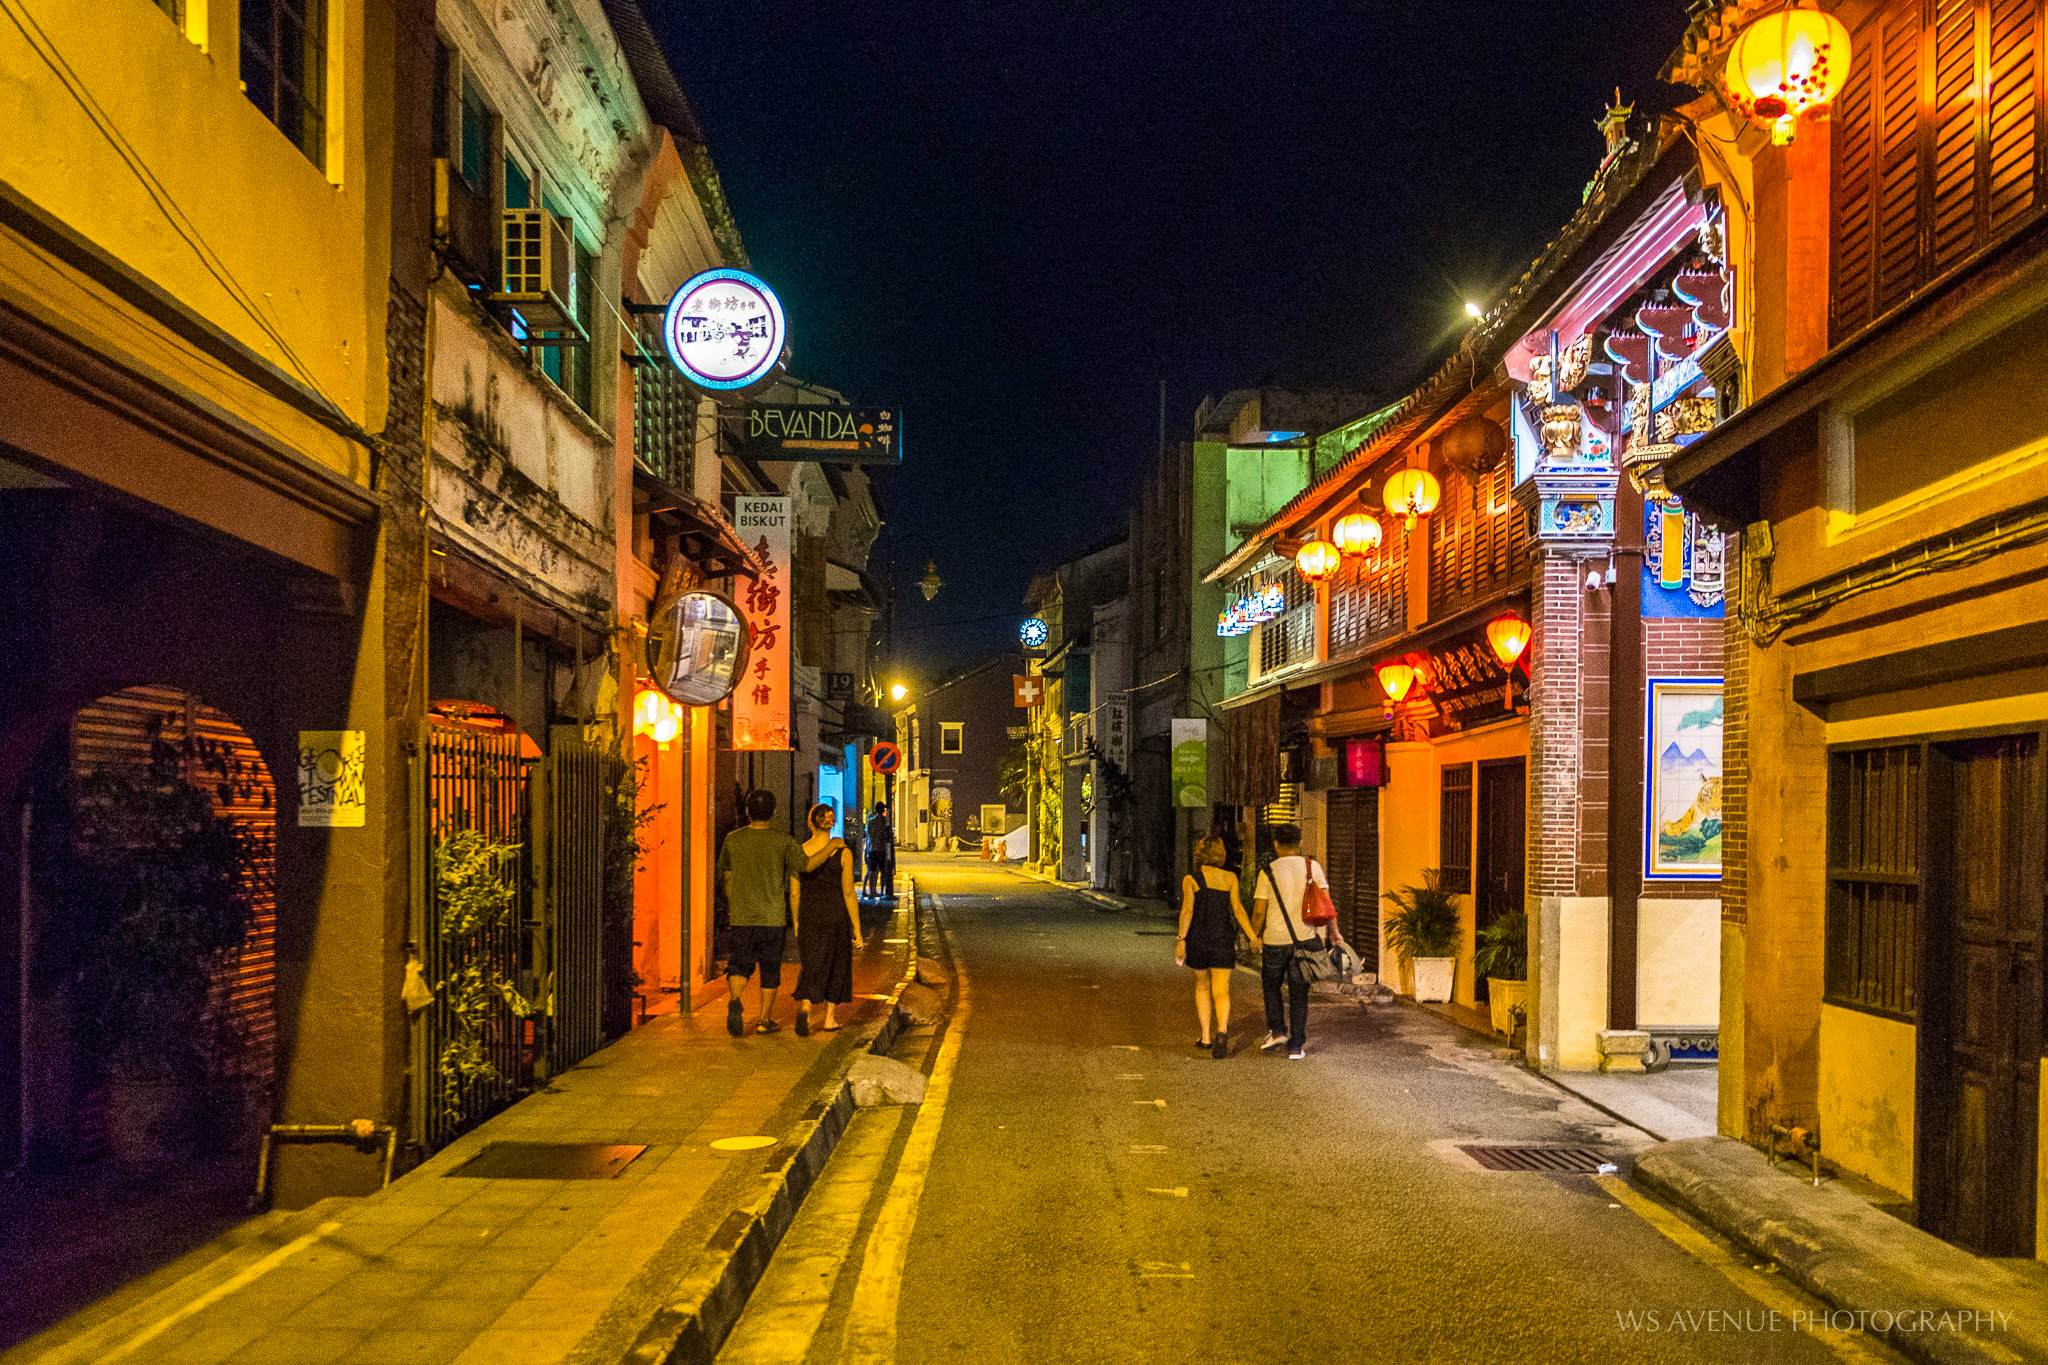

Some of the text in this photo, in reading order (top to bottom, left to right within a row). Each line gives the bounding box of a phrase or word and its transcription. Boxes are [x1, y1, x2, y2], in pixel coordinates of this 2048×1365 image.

[751, 409, 859, 439] BEVANDA
[743, 501, 783, 514] KEDAI
[740, 515, 786, 527] BISKUT
[832, 674, 850, 689] 19
